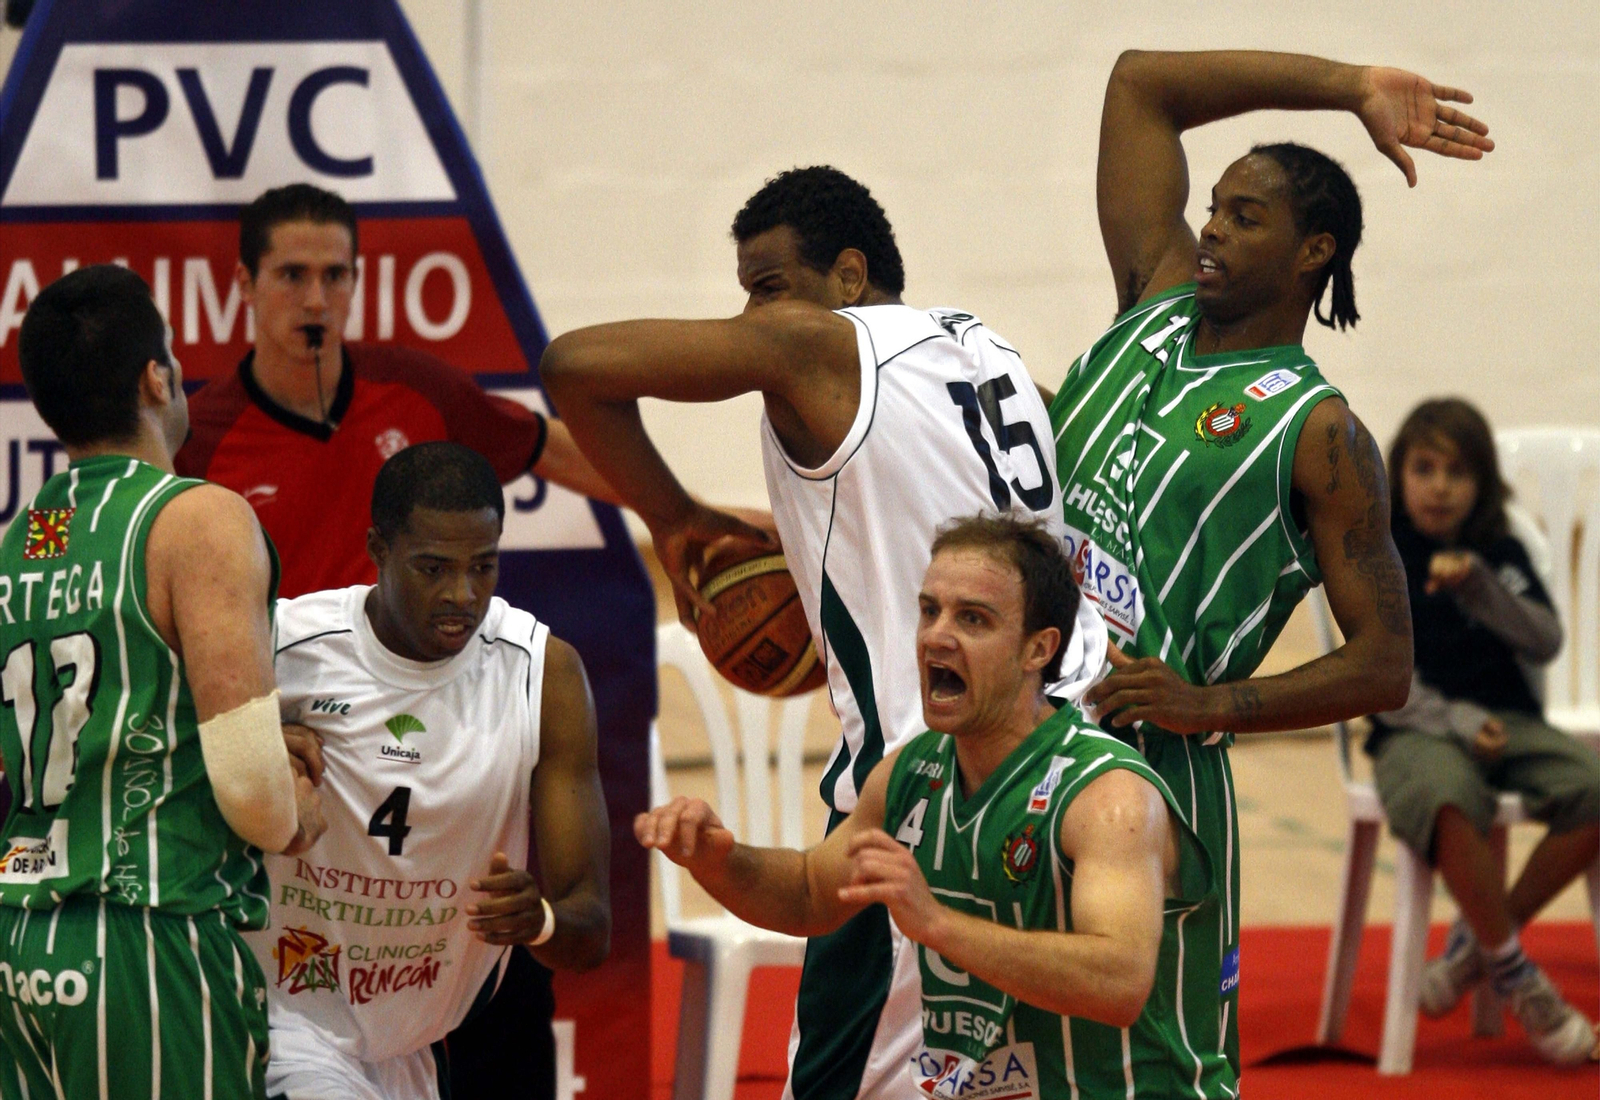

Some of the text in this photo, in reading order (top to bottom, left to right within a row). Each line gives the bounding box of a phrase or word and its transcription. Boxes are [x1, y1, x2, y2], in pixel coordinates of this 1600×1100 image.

[93, 66, 375, 181] PVC
[946, 373, 1053, 513] 15
[1065, 482, 1132, 551] HUESC
[311, 698, 351, 716] vive
[381, 745, 421, 761] Unicaja
[367, 786, 412, 857] 4
[894, 796, 930, 853] 4
[13, 857, 29, 874] DE
[295, 857, 458, 900] INSTITUTO
[279, 884, 459, 927] FERTILIDAD
[347, 938, 447, 961] CLINICAS
